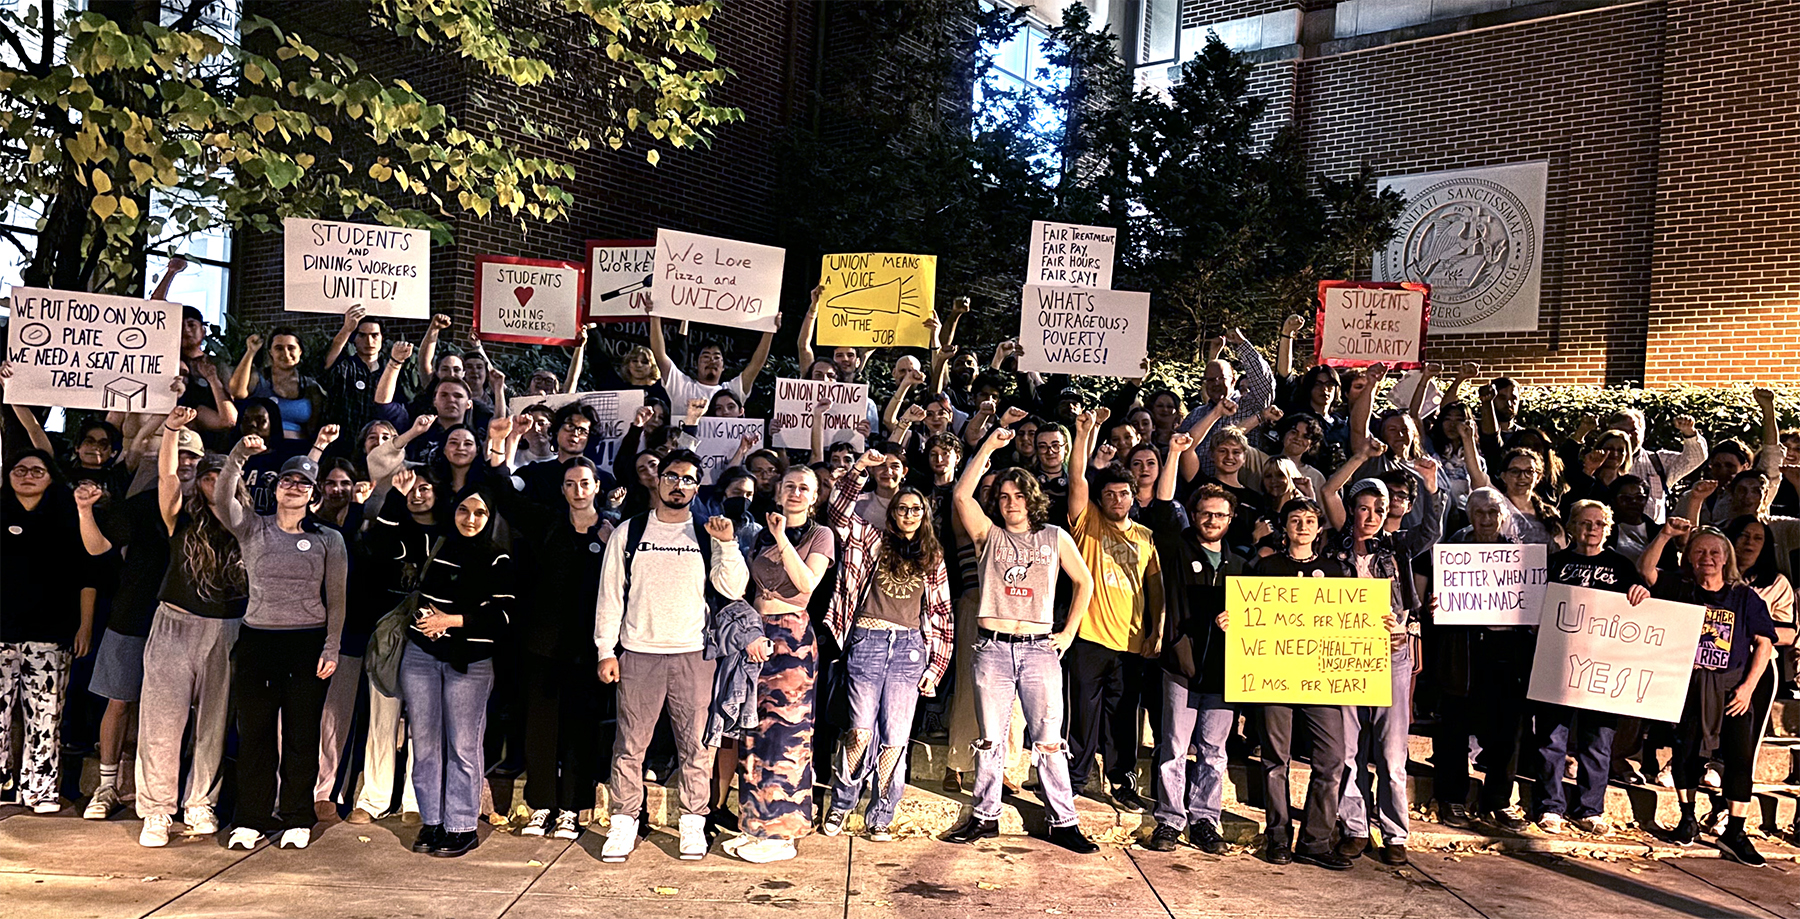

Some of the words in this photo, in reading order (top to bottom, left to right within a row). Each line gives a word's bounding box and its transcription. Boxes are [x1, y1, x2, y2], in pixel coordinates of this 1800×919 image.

[1447, 187, 1523, 238] SANCTISSIMAE
[312, 223, 412, 251] STUDENTS
[1043, 223, 1068, 242] FAIR
[347, 248, 369, 256] AND
[663, 237, 704, 264] We
[715, 248, 752, 268] Love
[1042, 242, 1066, 255] FAIR
[1069, 243, 1088, 258] PAY,
[303, 255, 353, 271] DINING
[358, 260, 417, 278] WORKERS
[882, 256, 920, 269] MEANS
[1041, 256, 1065, 267] FAIR
[497, 269, 562, 288] STUDENTS
[666, 263, 704, 284] Pizza
[714, 275, 737, 286] and
[825, 276, 831, 284] A
[841, 272, 875, 288] VOICE
[1041, 268, 1066, 281] FAIR
[1069, 270, 1098, 287] SAY!
[323, 275, 398, 300] UNITED!
[1475, 262, 1521, 311] COLLEGE
[671, 285, 762, 315] UNIONS!
[1038, 288, 1095, 313] WHAT'S
[1341, 290, 1410, 311] STUDENTS
[15, 296, 37, 318] WE
[41, 298, 64, 321] PUT
[67, 300, 99, 322] FOOD
[104, 307, 126, 324] ON
[131, 307, 166, 330] YOUR
[498, 308, 544, 320] DINING
[832, 313, 848, 327] ON
[849, 319, 872, 331] THE
[1038, 310, 1129, 334] OUTRAGEOUS?
[1341, 318, 1400, 332] WORKERS
[63, 327, 103, 346] PLATE
[872, 330, 895, 345] JOB
[1043, 329, 1106, 348] POVERTY
[1337, 336, 1413, 355] SOLIDARITY
[9, 347, 30, 363] WE
[34, 348, 68, 365] NEED
[70, 351, 80, 367] A
[86, 351, 119, 370] SEAT
[120, 354, 136, 374] AT
[140, 354, 163, 374] THE
[1044, 348, 1108, 365] WAGES!
[51, 370, 93, 388] TABLE
[779, 382, 813, 401] UNION
[817, 384, 861, 404] BUSTING
[805, 402, 813, 412] IS
[801, 413, 814, 428] TO
[823, 413, 860, 430] TOMACH
[1440, 550, 1472, 565] FOOD
[1479, 549, 1520, 563] TASTES
[1443, 569, 1490, 587] BETTER
[1493, 569, 1528, 587] WHEN
[1559, 563, 1618, 584] Eagles
[1236, 580, 1300, 603] WE'RE
[1314, 588, 1368, 604] ALIVE
[1439, 591, 1526, 612] UNION-MADE
[1244, 607, 1266, 627] 12
[1274, 613, 1305, 627] MOS.
[1313, 615, 1334, 627] PER
[1337, 612, 1376, 629] YEAR.
[1555, 601, 1666, 646] Union
[1241, 638, 1267, 656] WE
[1275, 639, 1318, 656] NEED
[1321, 640, 1372, 657] HEALTH
[1322, 657, 1384, 670] INSURANCE
[1700, 649, 1729, 667] RISE
[1241, 673, 1256, 692] 12
[1262, 679, 1290, 691] MOS.
[1301, 680, 1321, 691] PER
[1327, 678, 1366, 694] YEAR!
[1569, 654, 1654, 703] YES!
